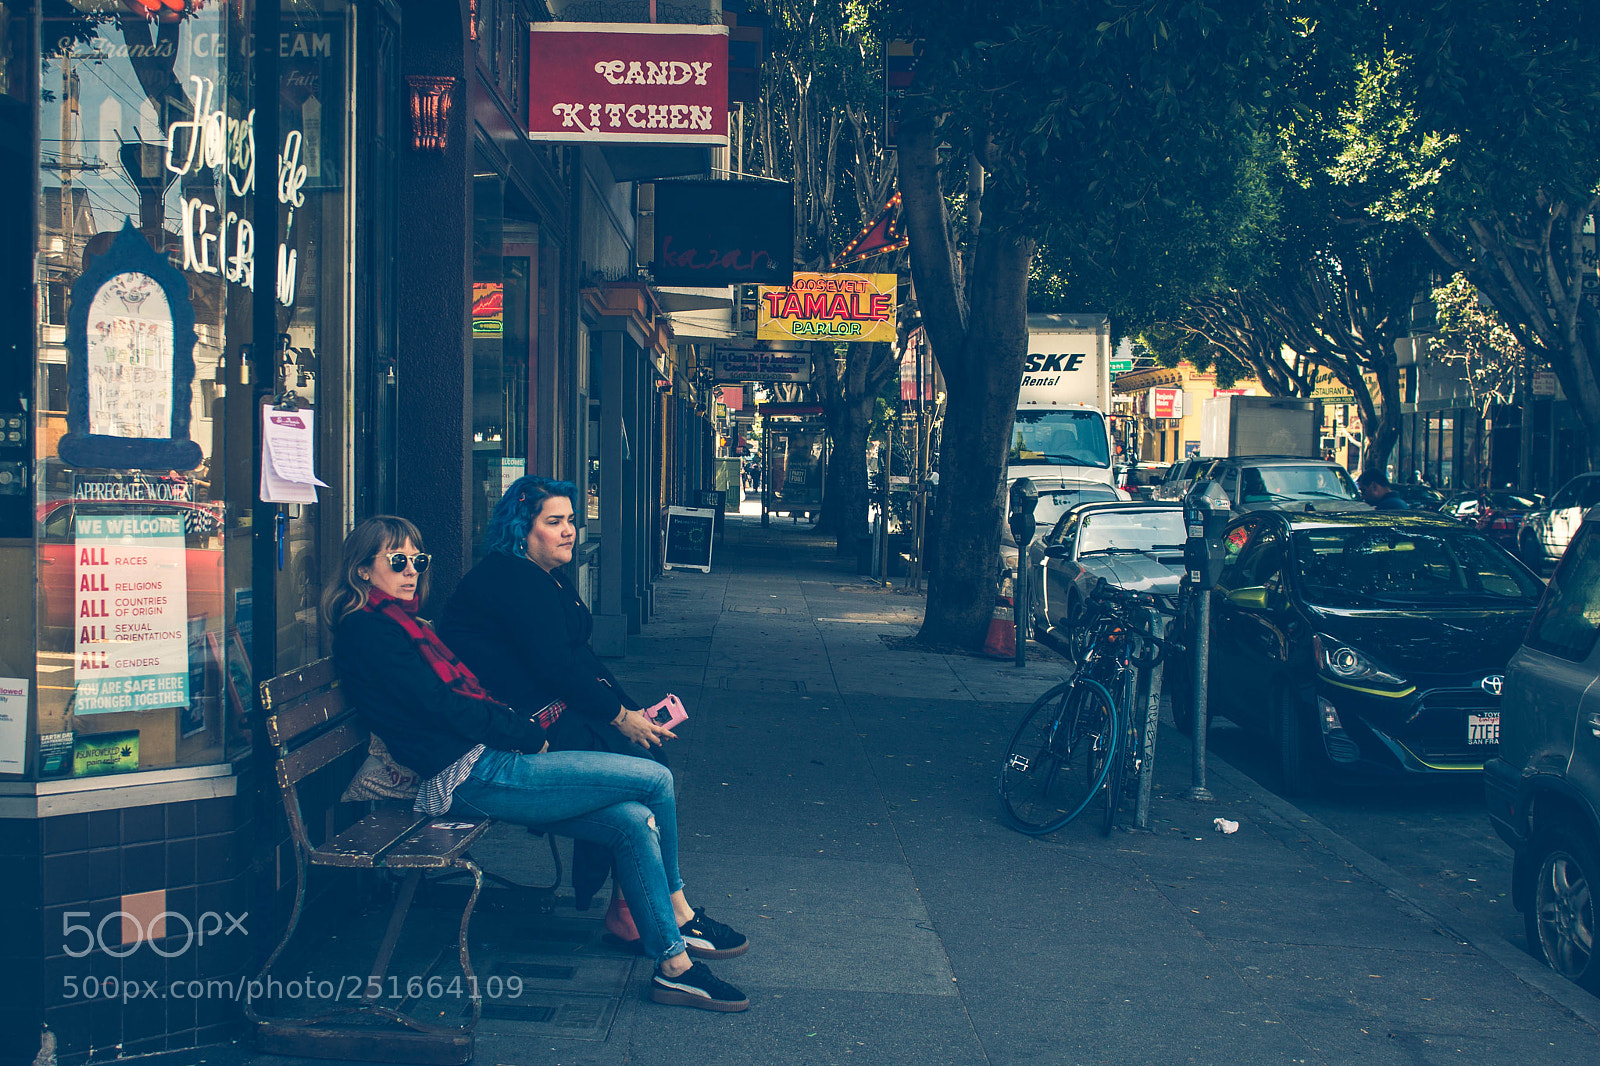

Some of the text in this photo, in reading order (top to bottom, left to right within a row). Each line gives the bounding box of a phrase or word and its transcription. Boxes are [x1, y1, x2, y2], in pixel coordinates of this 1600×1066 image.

[241, 33, 331, 58] CEAM
[594, 60, 712, 86] CANDY
[552, 103, 713, 133] KITCHEN
[763, 293, 891, 321] TAMALE
[791, 321, 861, 335] PARLOR
[1021, 375, 1060, 387] Rental
[76, 482, 193, 501] APPRECIATE WOMEN
[78, 518, 180, 535] WE WELCOME
[80, 548, 148, 566] ALL RACES
[80, 573, 162, 592] ALL RELIGIONS
[80, 597, 168, 618] ALL COUNTRIES
[115, 606, 163, 617] OF ORIGIN
[80, 623, 152, 644] ALL SEXUAL
[115, 631, 182, 641] ORIENTATIONS
[80, 651, 160, 670] ALL GENDERS
[78, 677, 183, 697] YOU ARE SAFE HERE
[77, 691, 184, 710] STRONGER TOGETHER
